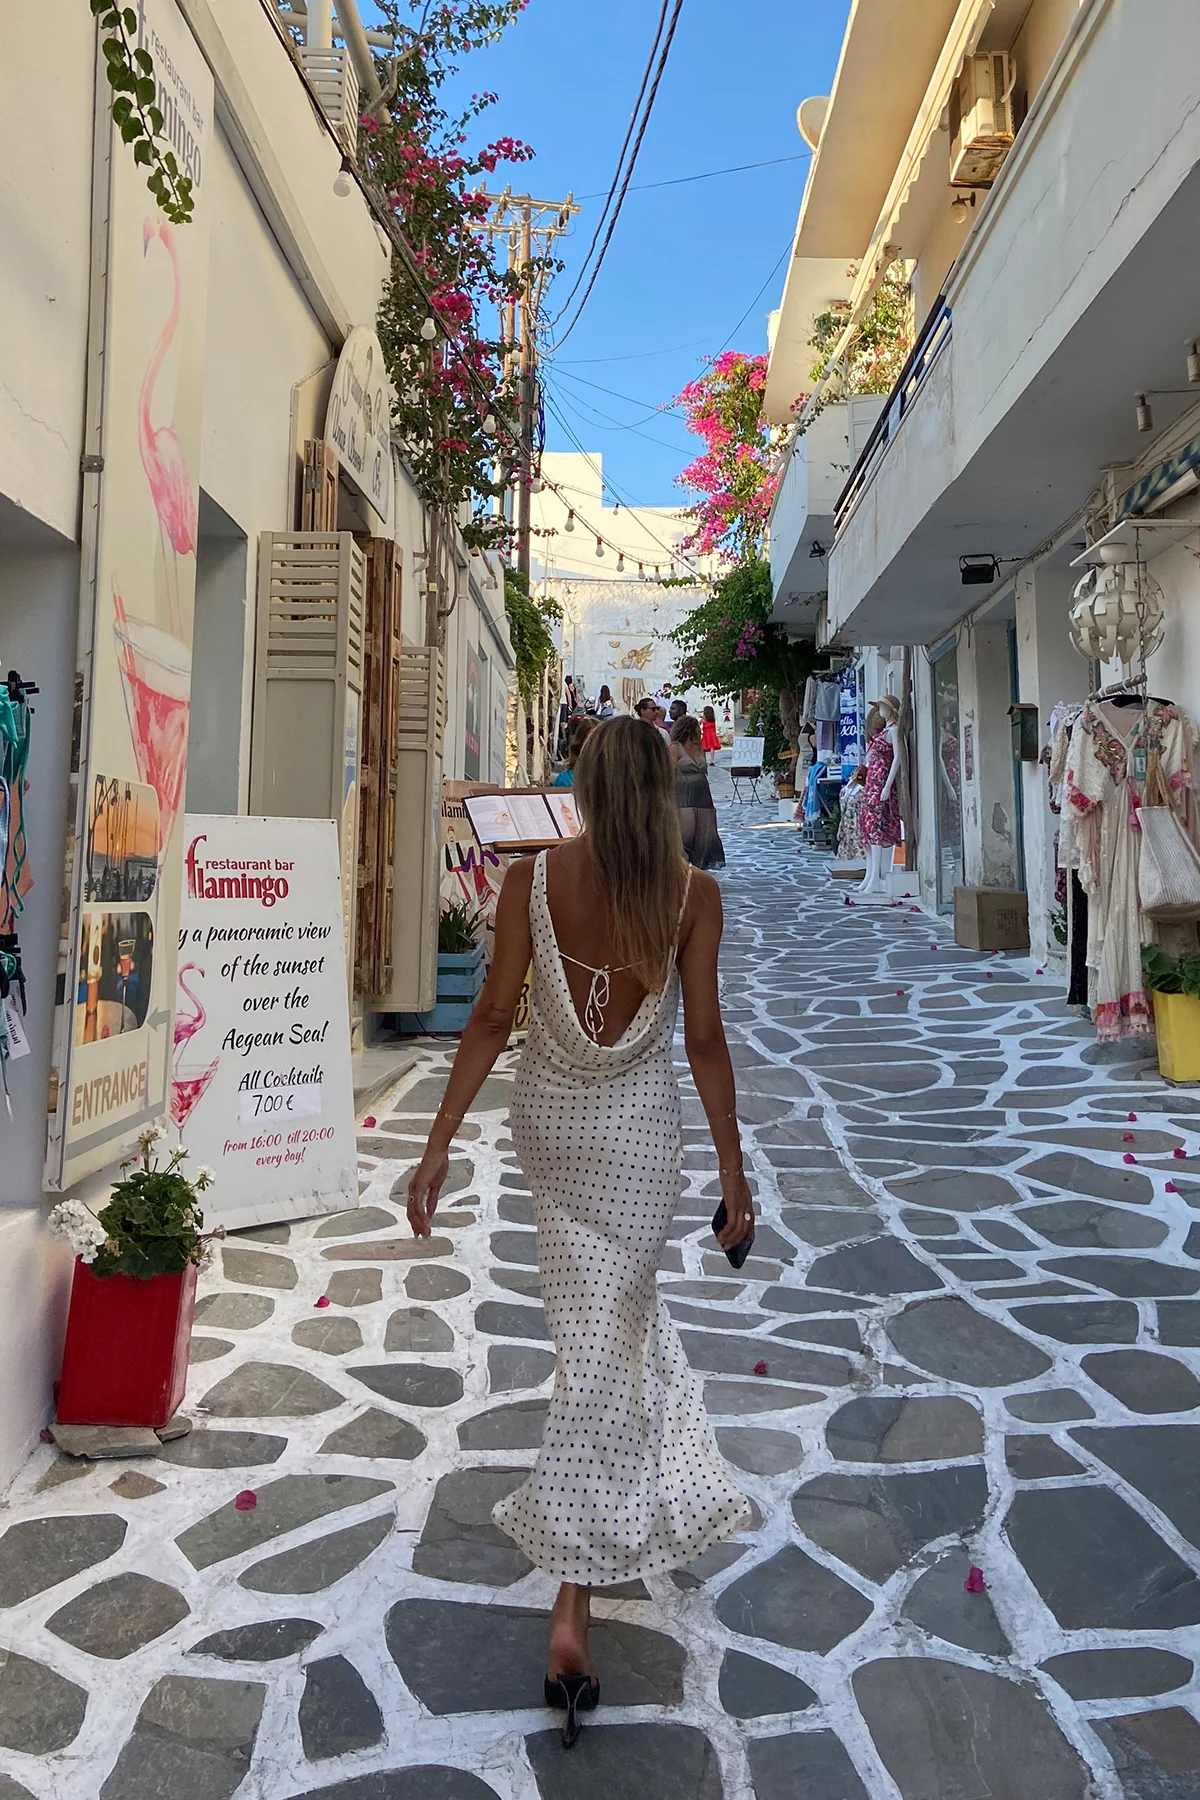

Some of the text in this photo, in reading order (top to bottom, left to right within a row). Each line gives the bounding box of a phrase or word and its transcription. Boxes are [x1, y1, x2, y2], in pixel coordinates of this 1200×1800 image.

[151, 28, 204, 135] restaurant bar
[441, 800, 469, 819] lami
[185, 834, 289, 908] flamingo
[205, 859, 295, 871] restaurant bar
[192, 930, 202, 942] a
[205, 921, 294, 950] panoramic
[299, 921, 331, 940] view
[221, 953, 325, 983] of the sunset
[243, 986, 310, 1012] over the
[221, 1020, 330, 1057] Aegean Sea!
[237, 1064, 324, 1092] All Cocktails
[72, 1061, 147, 1126] ENTRANCE
[222, 1126, 335, 1156] from 16:00 till 20:00
[255, 1146, 307, 1169] every day!
